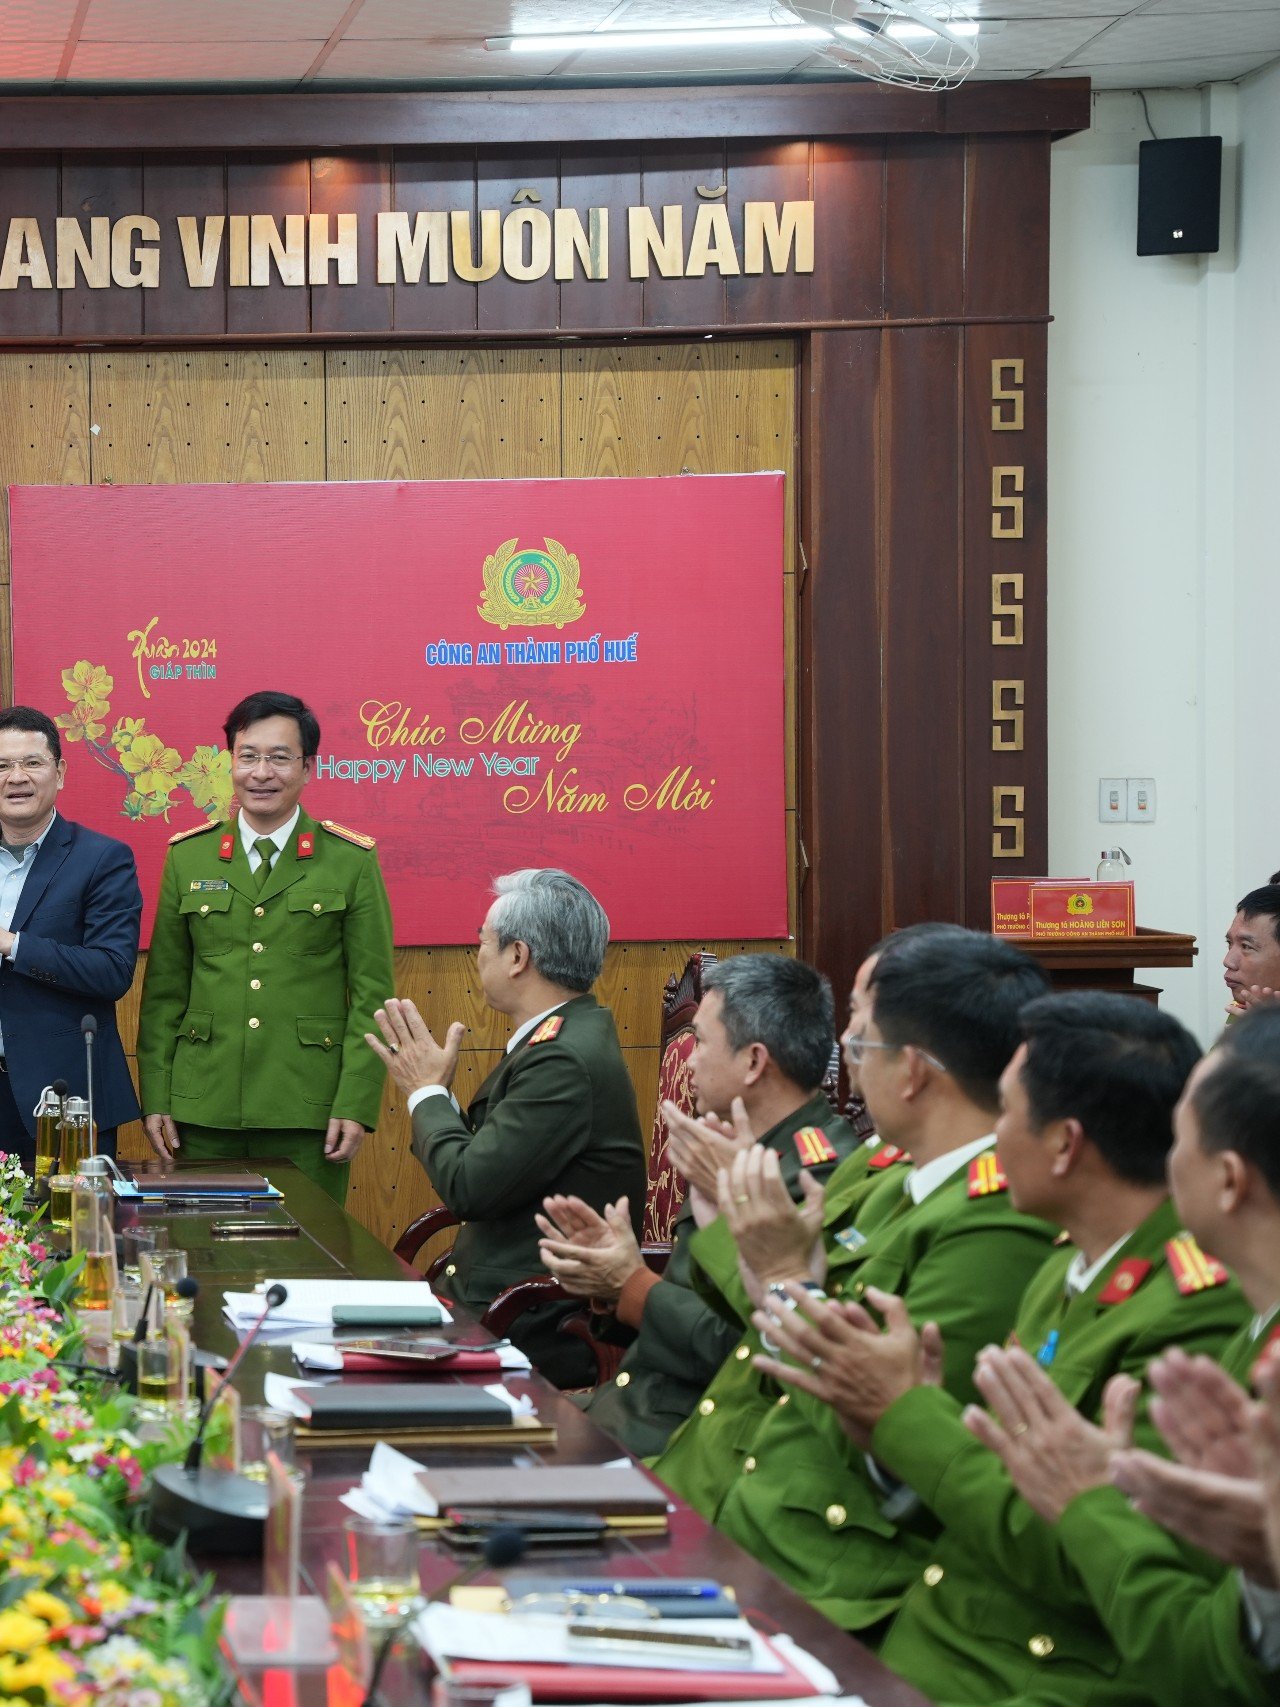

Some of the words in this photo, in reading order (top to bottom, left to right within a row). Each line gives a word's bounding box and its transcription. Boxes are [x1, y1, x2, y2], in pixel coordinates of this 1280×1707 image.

[176, 213, 357, 288] VINH
[377, 187, 609, 284] MUÔN
[629, 185, 814, 278] NĂM
[182, 638, 217, 658] 2024
[425, 639, 473, 666] CÔNG
[476, 642, 502, 665] AN
[505, 637, 560, 664] THÀNH
[565, 633, 602, 663] PHỐ
[604, 632, 639, 662] HUẾ
[149, 661, 182, 680] GIÁP
[186, 661, 216, 680] THÌN
[359, 699, 446, 751] Chúc
[459, 699, 581, 762] Mừng
[316, 755, 406, 784] Happy
[413, 753, 476, 778] New
[480, 752, 540, 777] Year
[502, 767, 609, 814] Năm
[623, 765, 716, 812] Mới
